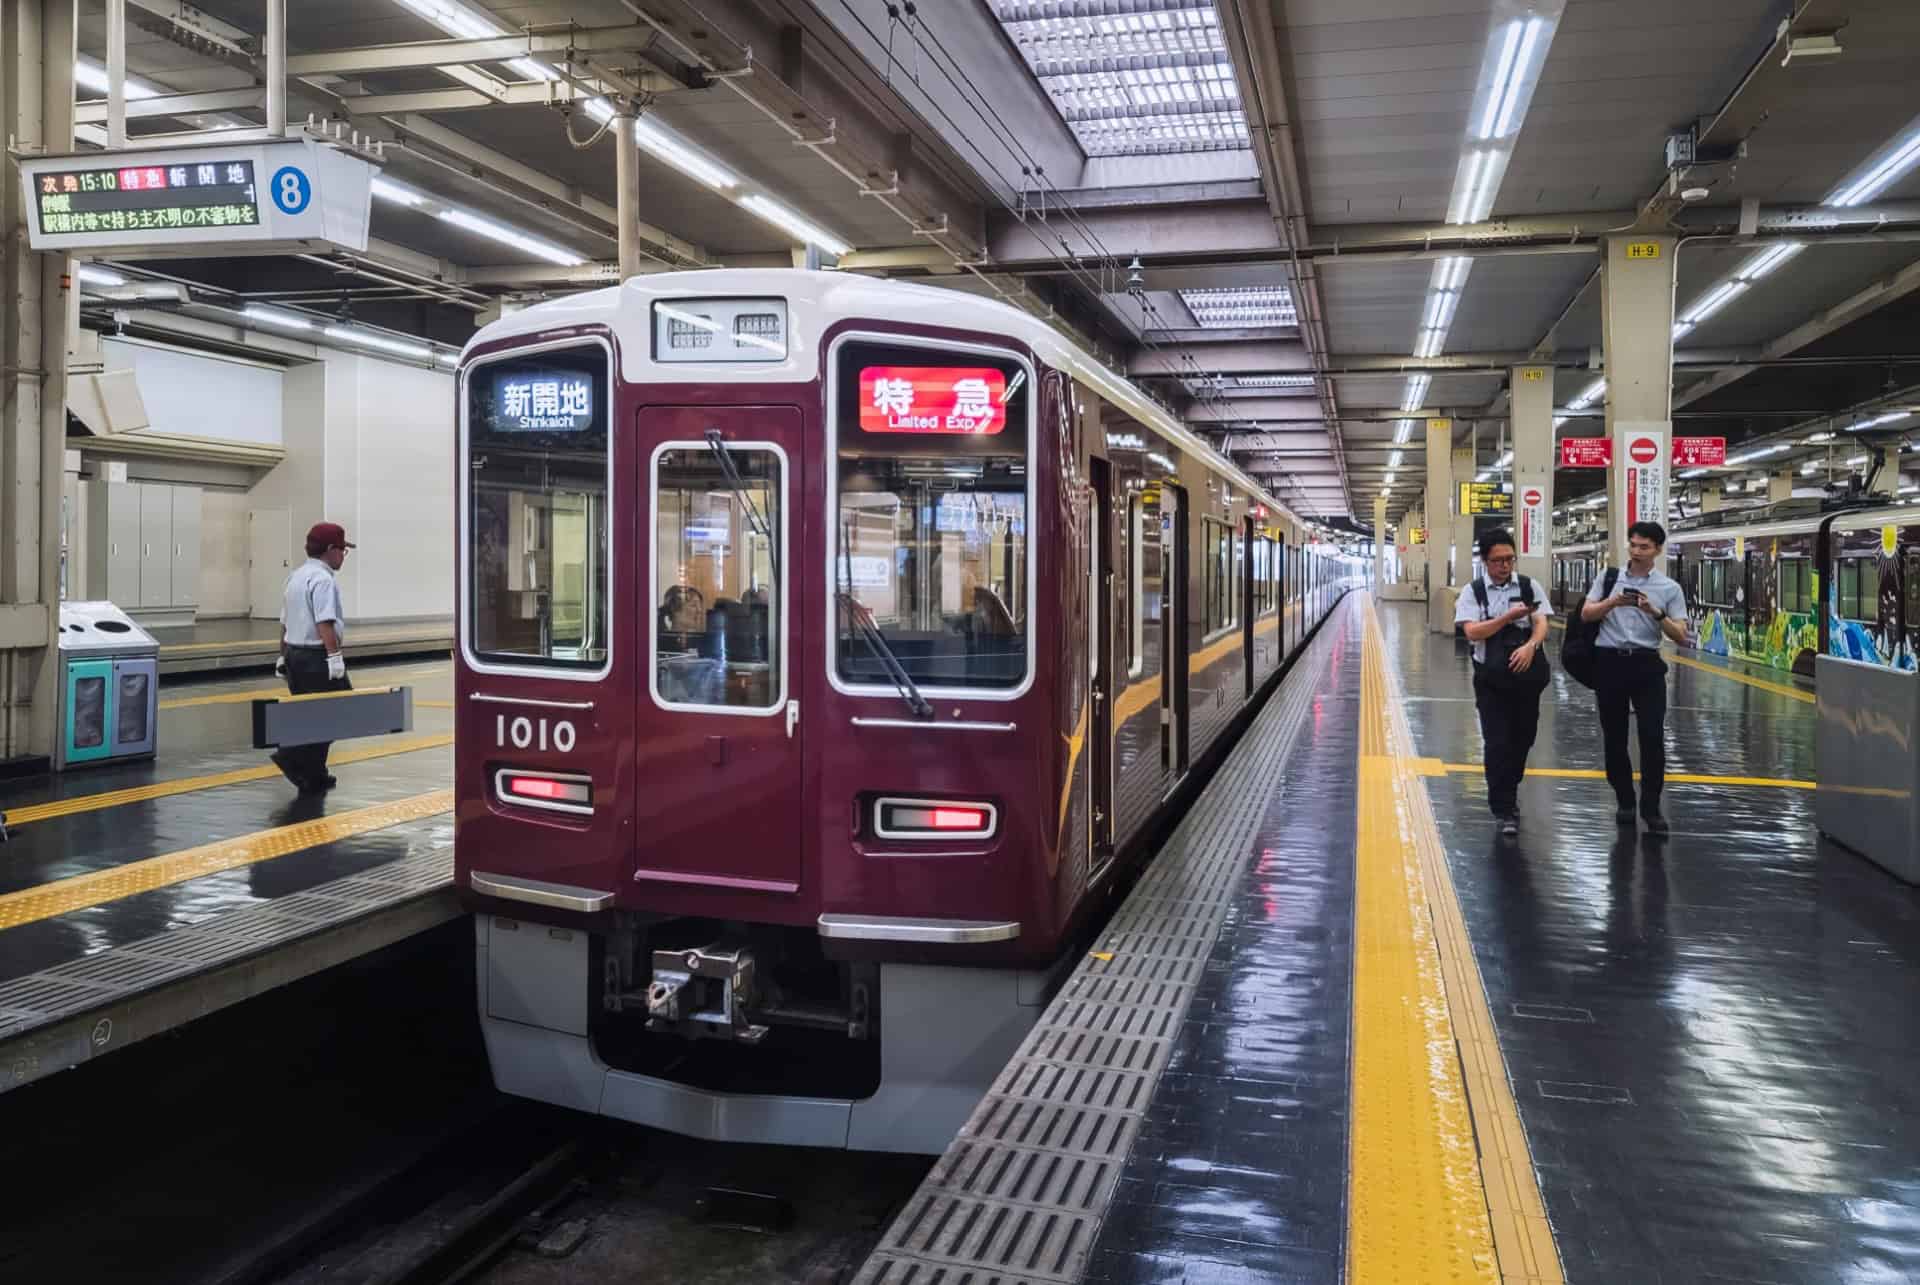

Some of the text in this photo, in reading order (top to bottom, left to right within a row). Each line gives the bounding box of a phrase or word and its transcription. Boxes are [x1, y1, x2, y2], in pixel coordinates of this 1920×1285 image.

[42, 163, 245, 193] 次発 15:10 特急 新開地
[281, 173, 302, 208] 8
[503, 381, 589, 417] 新開地
[873, 378, 995, 416] 特急
[520, 415, 574, 428] Shinkaichi
[889, 415, 939, 429] Limited
[497, 714, 576, 752] 1010
